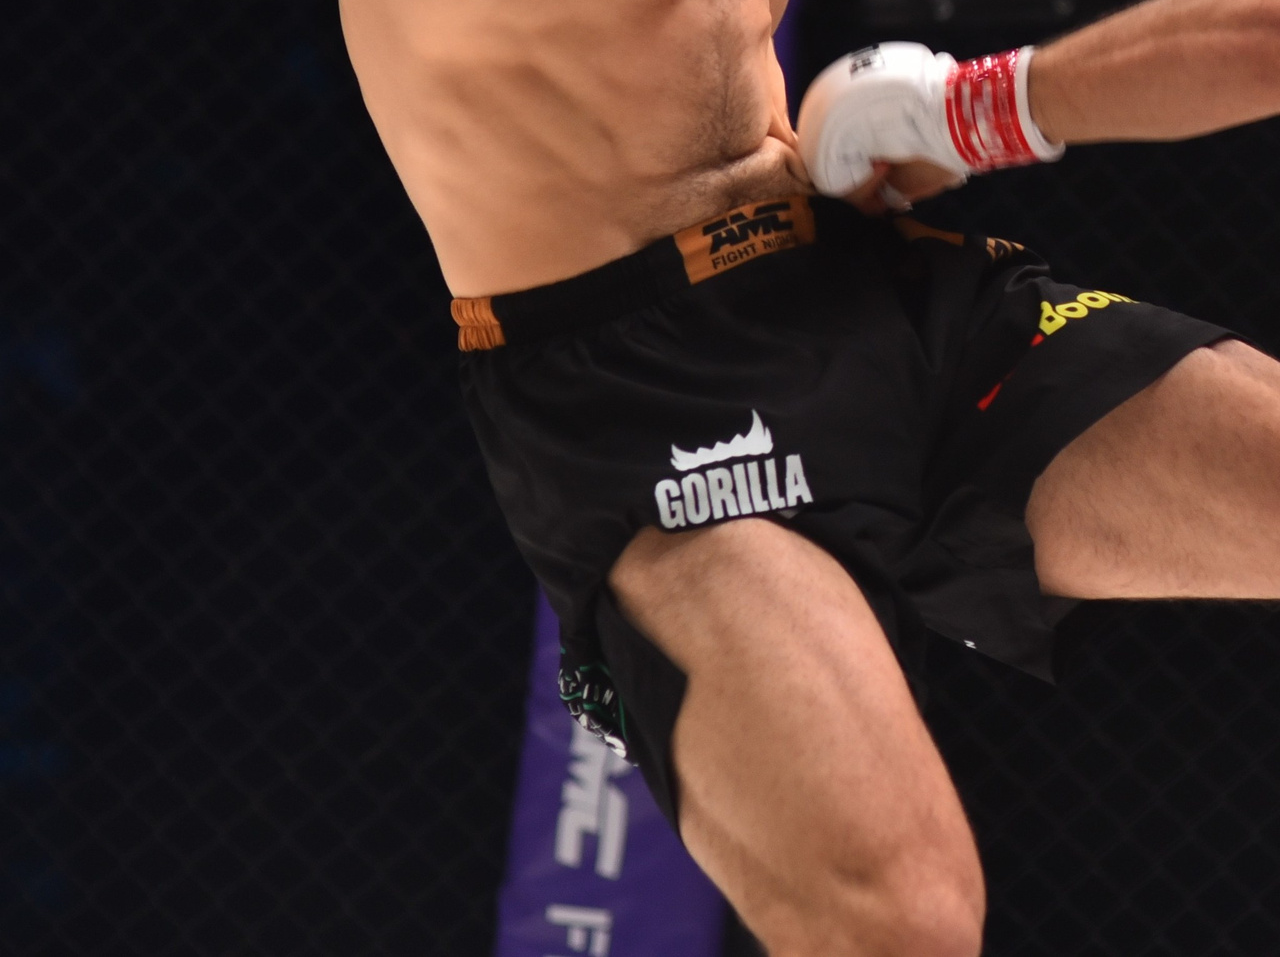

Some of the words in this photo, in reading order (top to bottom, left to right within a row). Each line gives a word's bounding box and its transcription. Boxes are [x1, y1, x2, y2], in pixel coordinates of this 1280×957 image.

[702, 201, 794, 255] AMC
[711, 243, 757, 270] FIGHT
[654, 453, 813, 529] GORILLA
